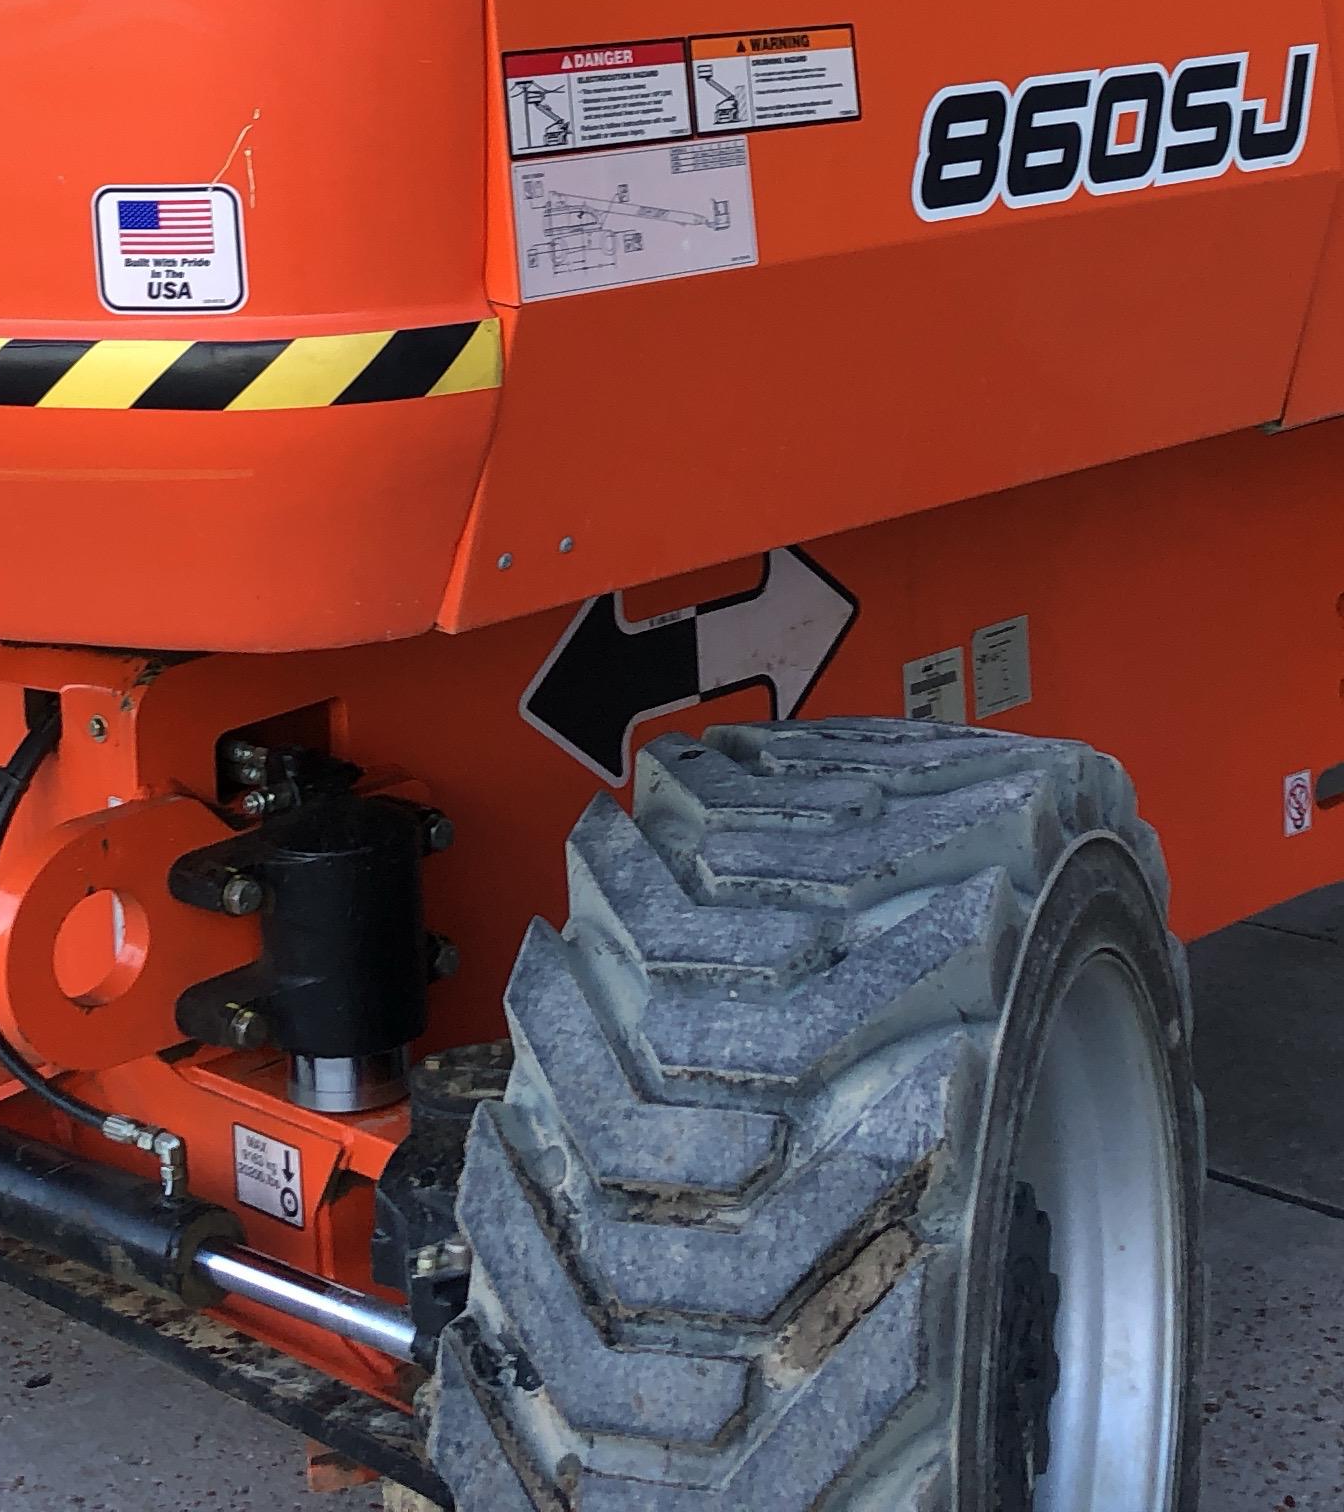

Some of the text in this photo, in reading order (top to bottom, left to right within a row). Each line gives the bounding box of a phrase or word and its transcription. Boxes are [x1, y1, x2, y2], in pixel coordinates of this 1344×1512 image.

[749, 34, 810, 52] WARNING
[574, 49, 634, 69] DANGER
[914, 46, 1317, 219] 860SJ
[147, 281, 193, 300] USA
